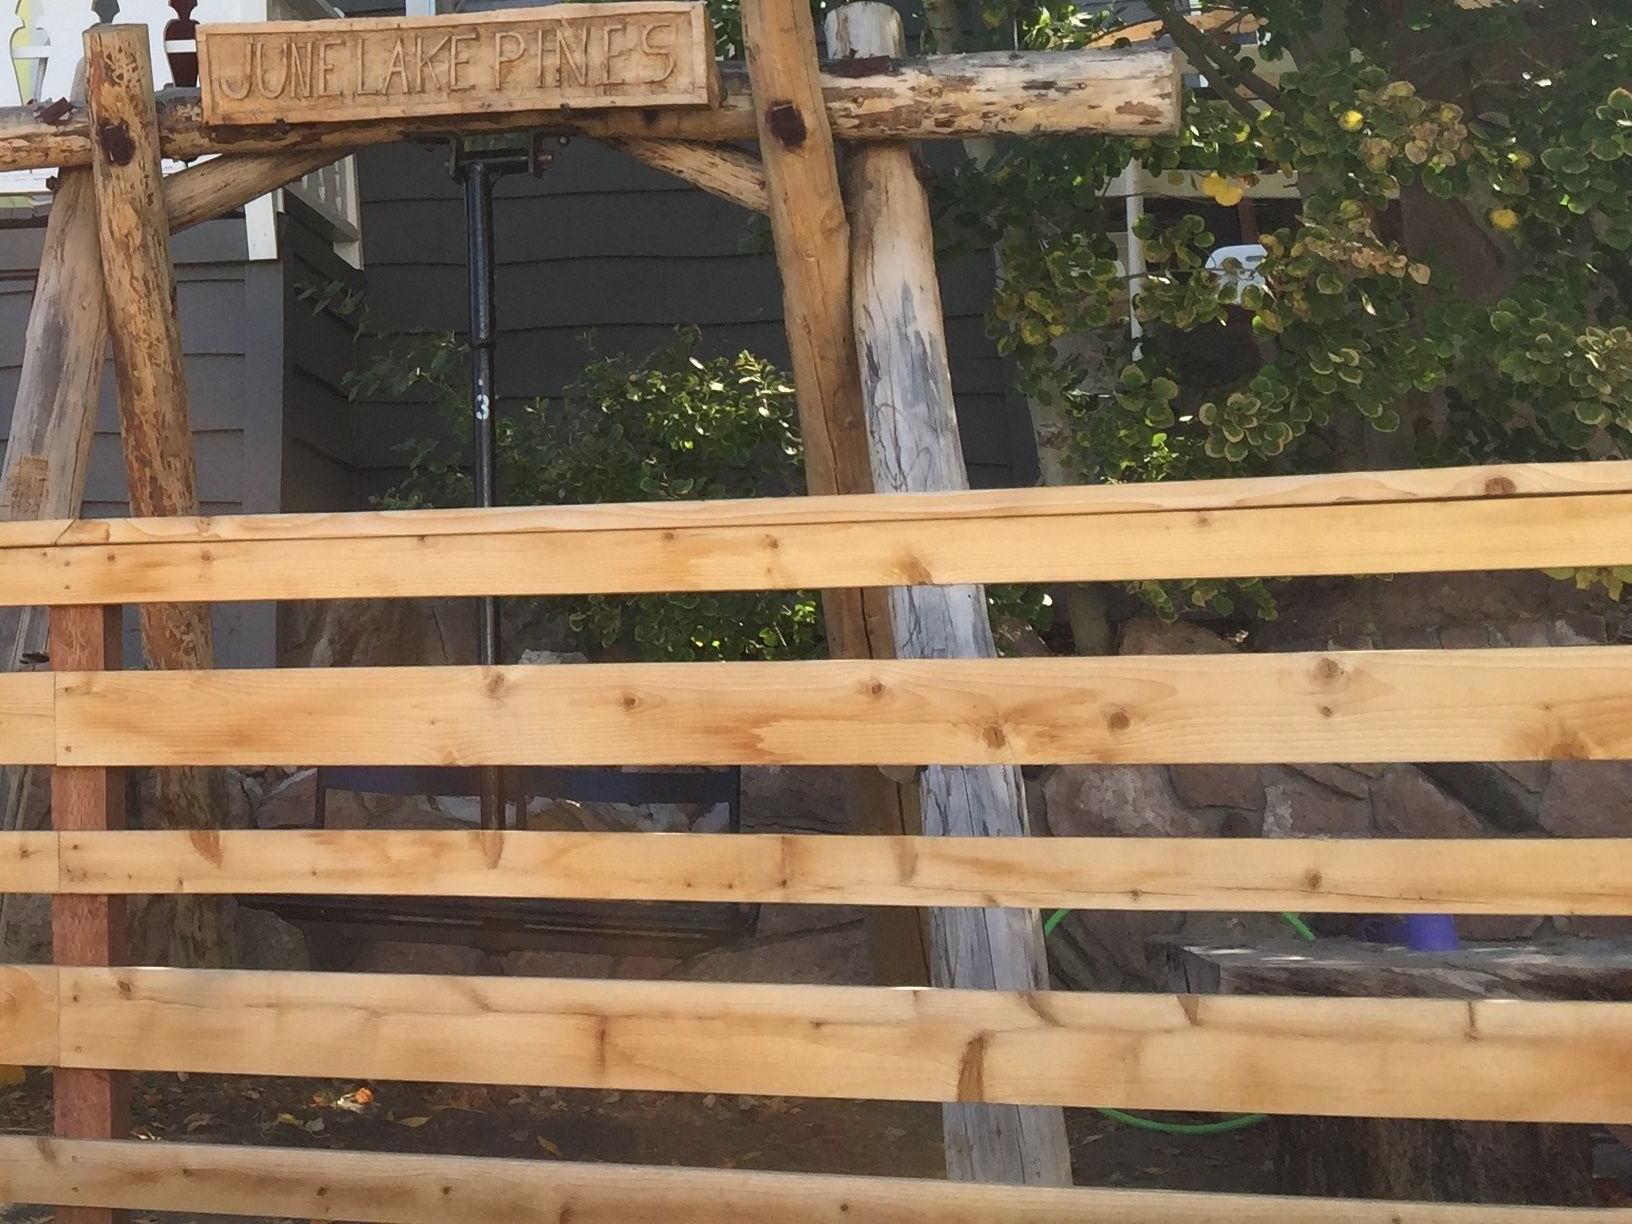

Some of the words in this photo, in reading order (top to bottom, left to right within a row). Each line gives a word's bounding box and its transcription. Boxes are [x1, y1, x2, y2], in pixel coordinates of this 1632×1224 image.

[220, 36, 346, 101] JUNE
[355, 30, 478, 96] LAKE
[494, 23, 677, 91] PINES
